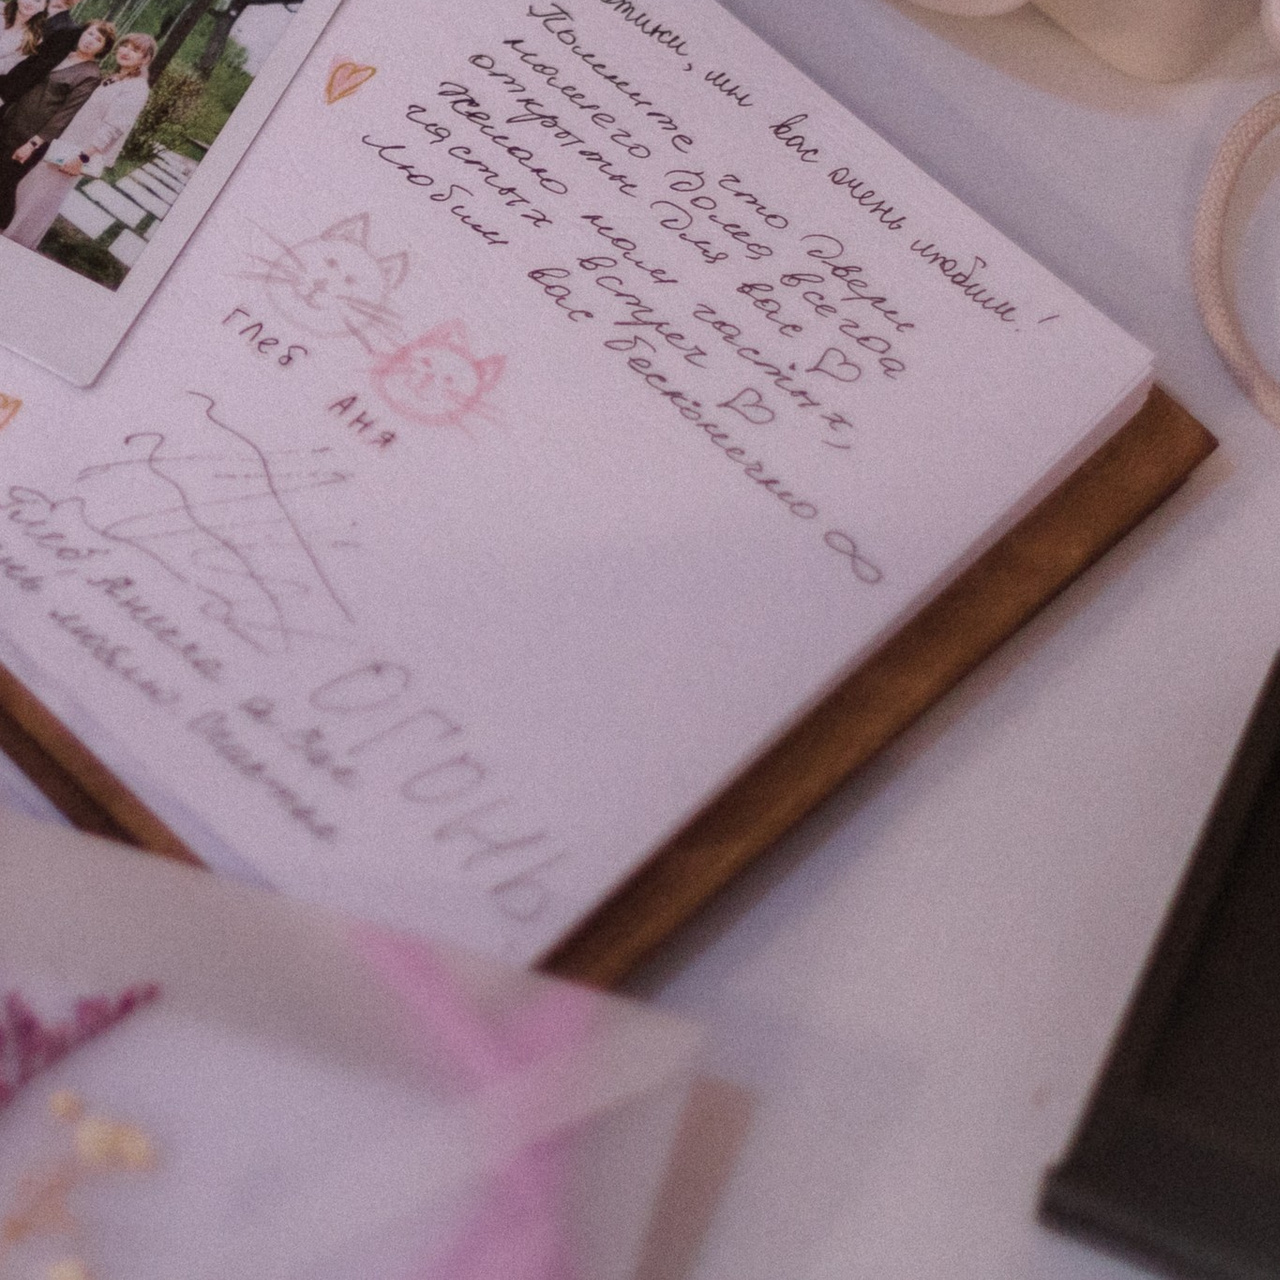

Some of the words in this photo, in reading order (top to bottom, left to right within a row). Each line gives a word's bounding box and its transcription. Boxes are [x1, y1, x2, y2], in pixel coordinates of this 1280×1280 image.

[468, 54, 638, 197] открыты
[650, 200, 728, 264] для
[736, 282, 803, 338] вас
[503, 39, 651, 158] нашего
[663, 169, 773, 261] дома
[780, 272, 906, 380] всегда
[704, 70, 753, 108] мы
[769, 113, 819, 163] вас
[827, 167, 907, 230] очень
[576, 256, 707, 369] встреч
[581, 214, 678, 284] нам
[718, 174, 789, 229] что
[800, 234, 914, 333] двери
[527, 267, 594, 322] вас
[603, 336, 818, 519] бесконечно
